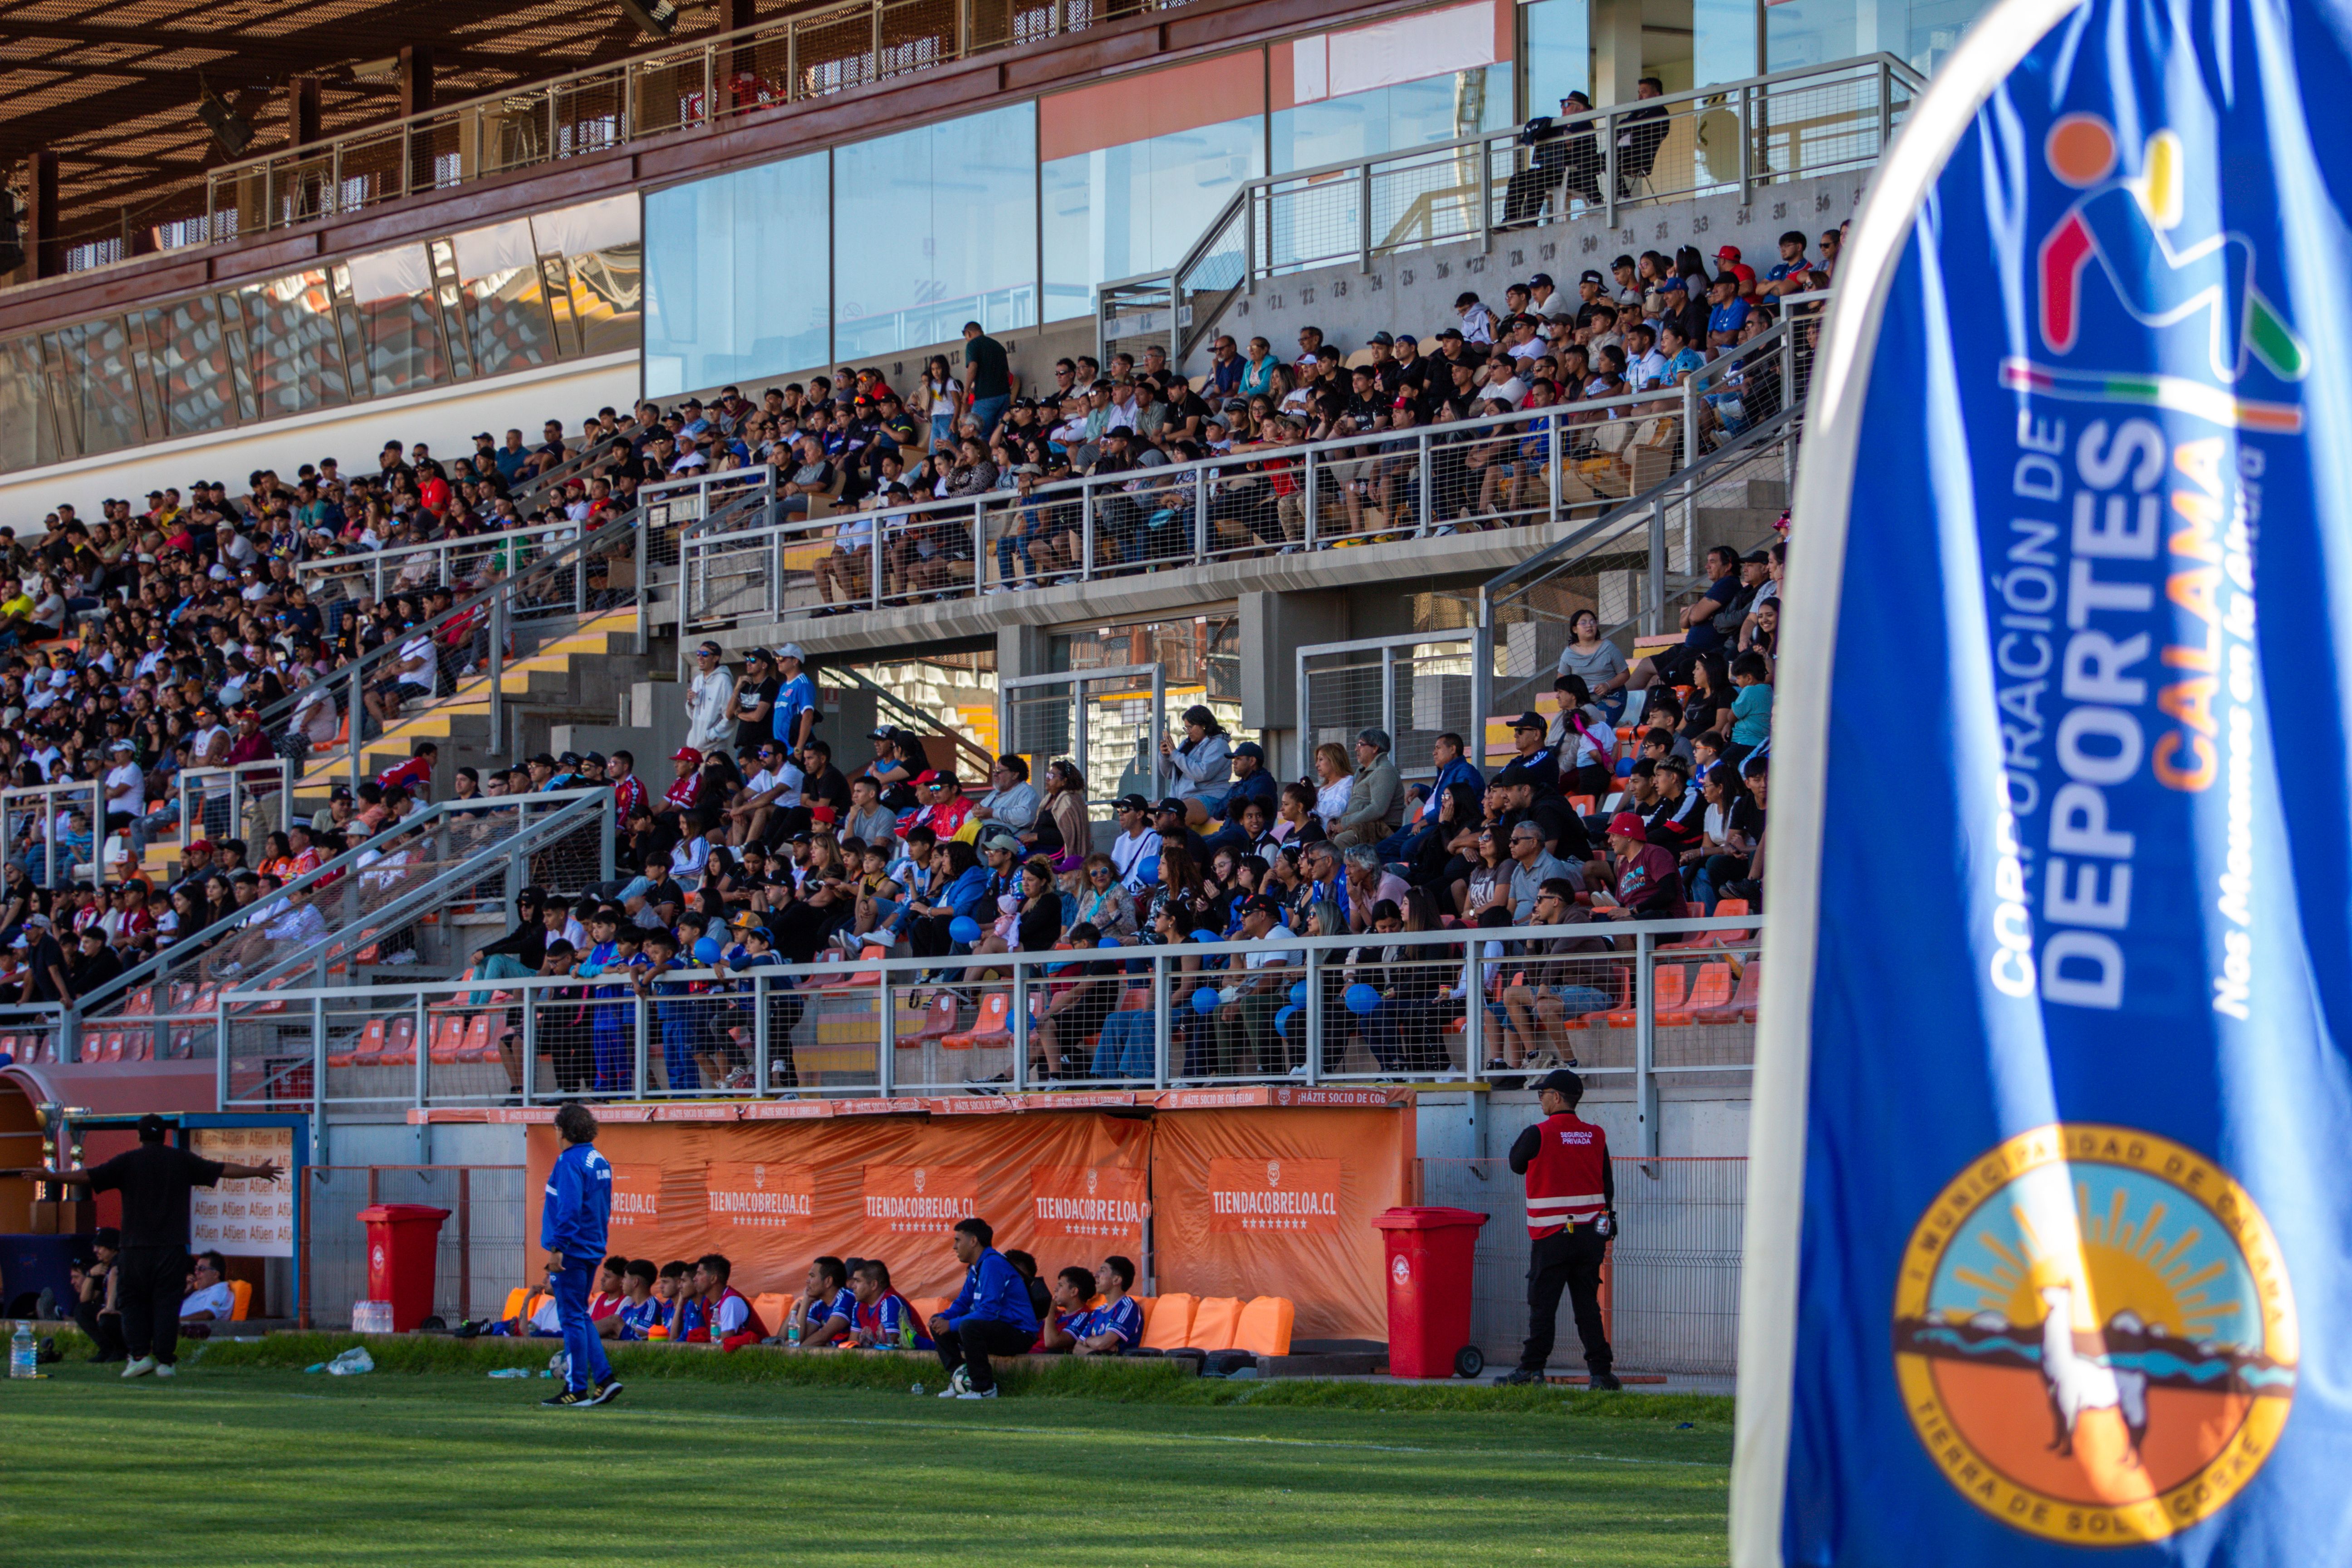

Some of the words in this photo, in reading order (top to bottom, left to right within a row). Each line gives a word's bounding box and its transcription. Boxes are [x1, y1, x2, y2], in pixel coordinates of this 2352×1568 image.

[1773, 202, 1787, 220] 35
[1816, 194, 1830, 212] 36
[1693, 216, 1709, 234] 33
[1736, 208, 1750, 225] 34
[1622, 229, 1635, 245] 31
[1437, 262, 1449, 279] 26
[1334, 281, 1347, 298] 23
[1371, 274, 1383, 291] 24
[1238, 300, 1250, 317] 20
[1271, 294, 1283, 310] 21
[2012, 408, 2066, 502] DE
[2151, 436, 2225, 793] CALAMA
[2040, 418, 2167, 1010] DEPORTES
[1990, 518, 2061, 999] CORPORACIÓN
[2213, 930, 2252, 1021] Nos
[971, 1101, 984, 1110] SOCIO
[985, 1100, 991, 1109] DE
[1200, 1094, 1216, 1104] SOCIO
[1217, 1094, 1224, 1103] DE
[1226, 1093, 1254, 1103] COBRELOA!
[1329, 1093, 1354, 1102] SOCIO
[1357, 1093, 1367, 1102] DE
[684, 1109, 696, 1118] SOCIO
[697, 1109, 703, 1117] DE
[776, 1107, 788, 1116] SOCIO
[789, 1107, 795, 1116] DE
[797, 1106, 821, 1115] COBRELOA!
[872, 1102, 886, 1111] SOCIO
[277, 1131, 292, 1146] Afü
[2163, 1153, 2205, 1190] DE
[277, 1202, 292, 1217] Afü
[709, 1192, 811, 1215] TIENDACOBRELOA.CL
[866, 1196, 975, 1219] TIENDACOBRELOA.CL
[1213, 1191, 1336, 1215] TIENDACOBRELOA.CL
[277, 1226, 292, 1240] Afü
[1916, 1401, 1996, 1499] TIERRA
[2008, 1494, 2048, 1525] DE
[2067, 1511, 2130, 1535] SOL
